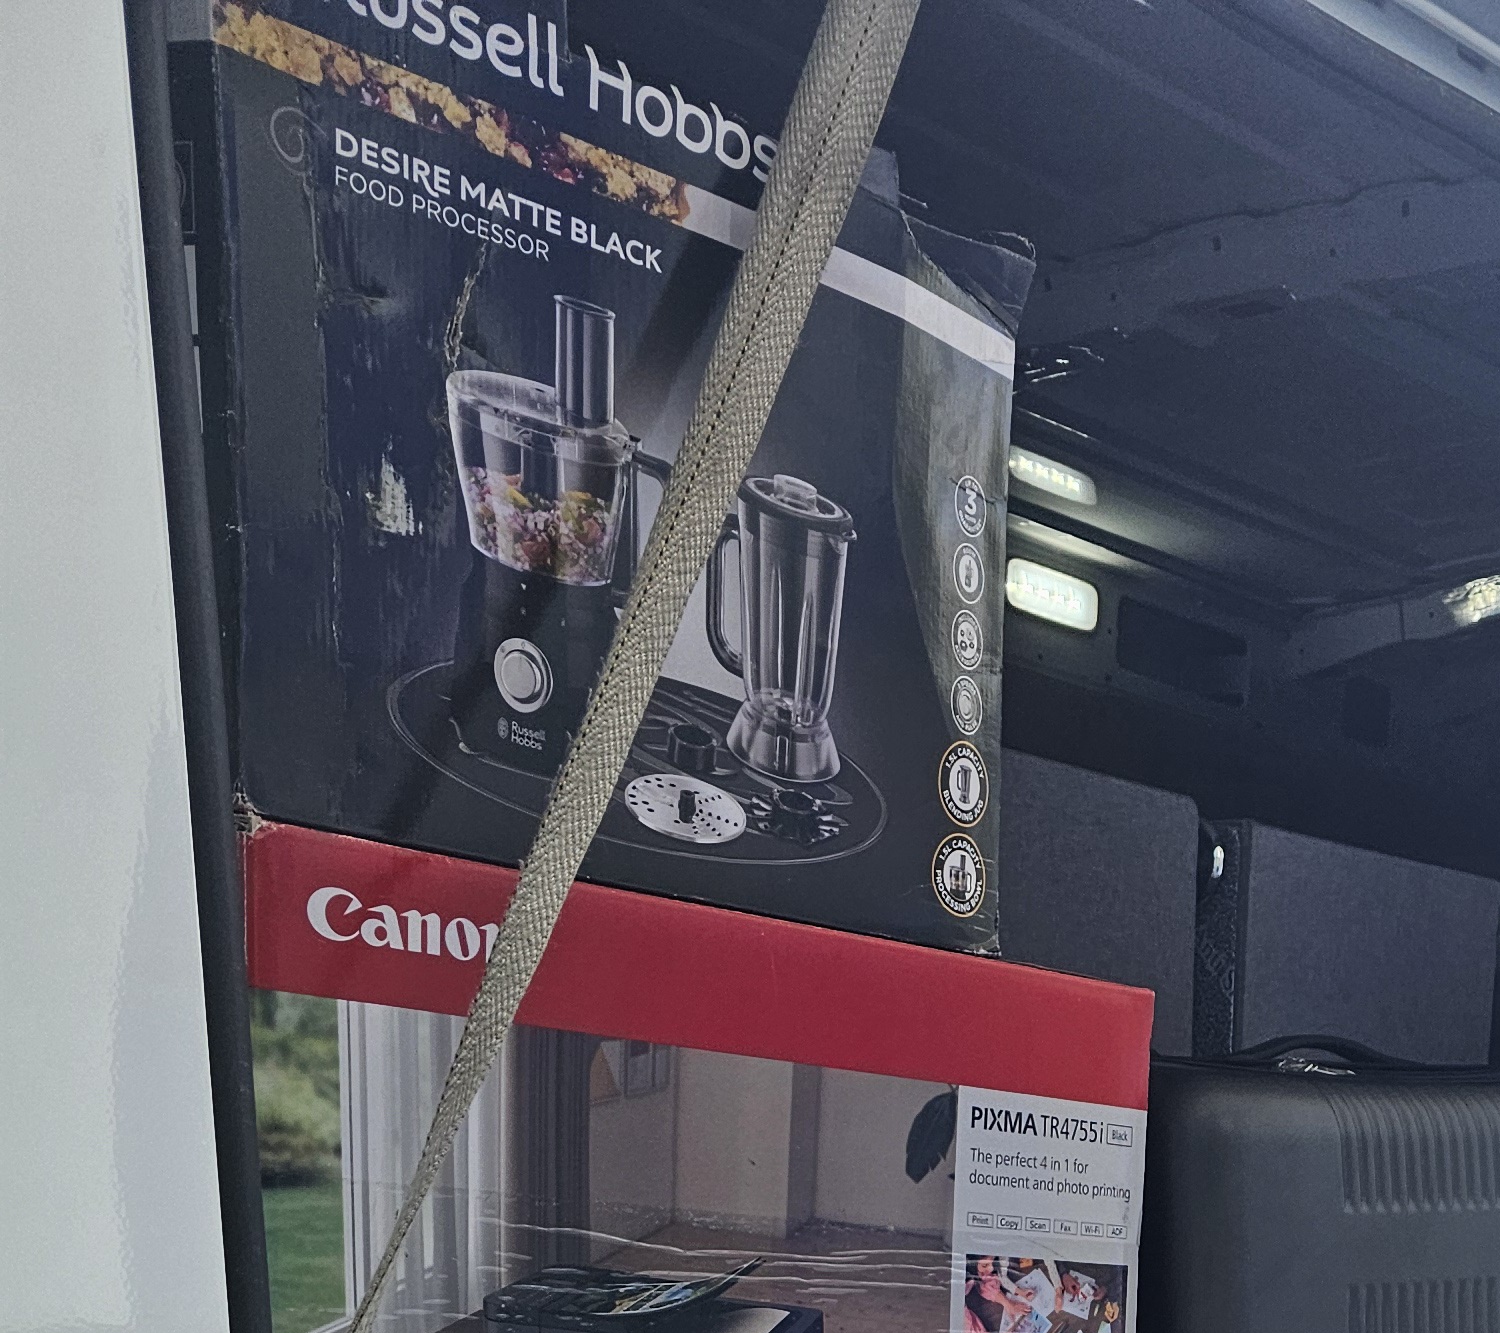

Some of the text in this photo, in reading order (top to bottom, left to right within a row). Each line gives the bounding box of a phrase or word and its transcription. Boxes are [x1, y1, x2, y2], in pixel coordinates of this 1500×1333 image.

[323, 0, 779, 184] ussell Hobbs
[335, 127, 663, 273] DESIRE MATTE BLACK
[335, 165, 550, 262] FOOD PROCESSOR
[511, 721, 546, 741] Russell
[511, 733, 543, 750] Hobbs
[957, 747, 985, 779] CAPACITY
[942, 789, 973, 822] BLENDING
[952, 839, 982, 869] CAPACITY
[935, 869, 971, 913] PROCESSING
[970, 1106, 1128, 1144] PIXMA TR4755i Black
[970, 1148, 1089, 1174] The perfect 4 in 1 for
[969, 1169, 1131, 1202] document and photo printing
[971, 1215, 989, 1225] Print
[999, 1218, 1019, 1230] Copy
[1029, 1220, 1046, 1230] Scan
[1060, 1222, 1071, 1232] Fax
